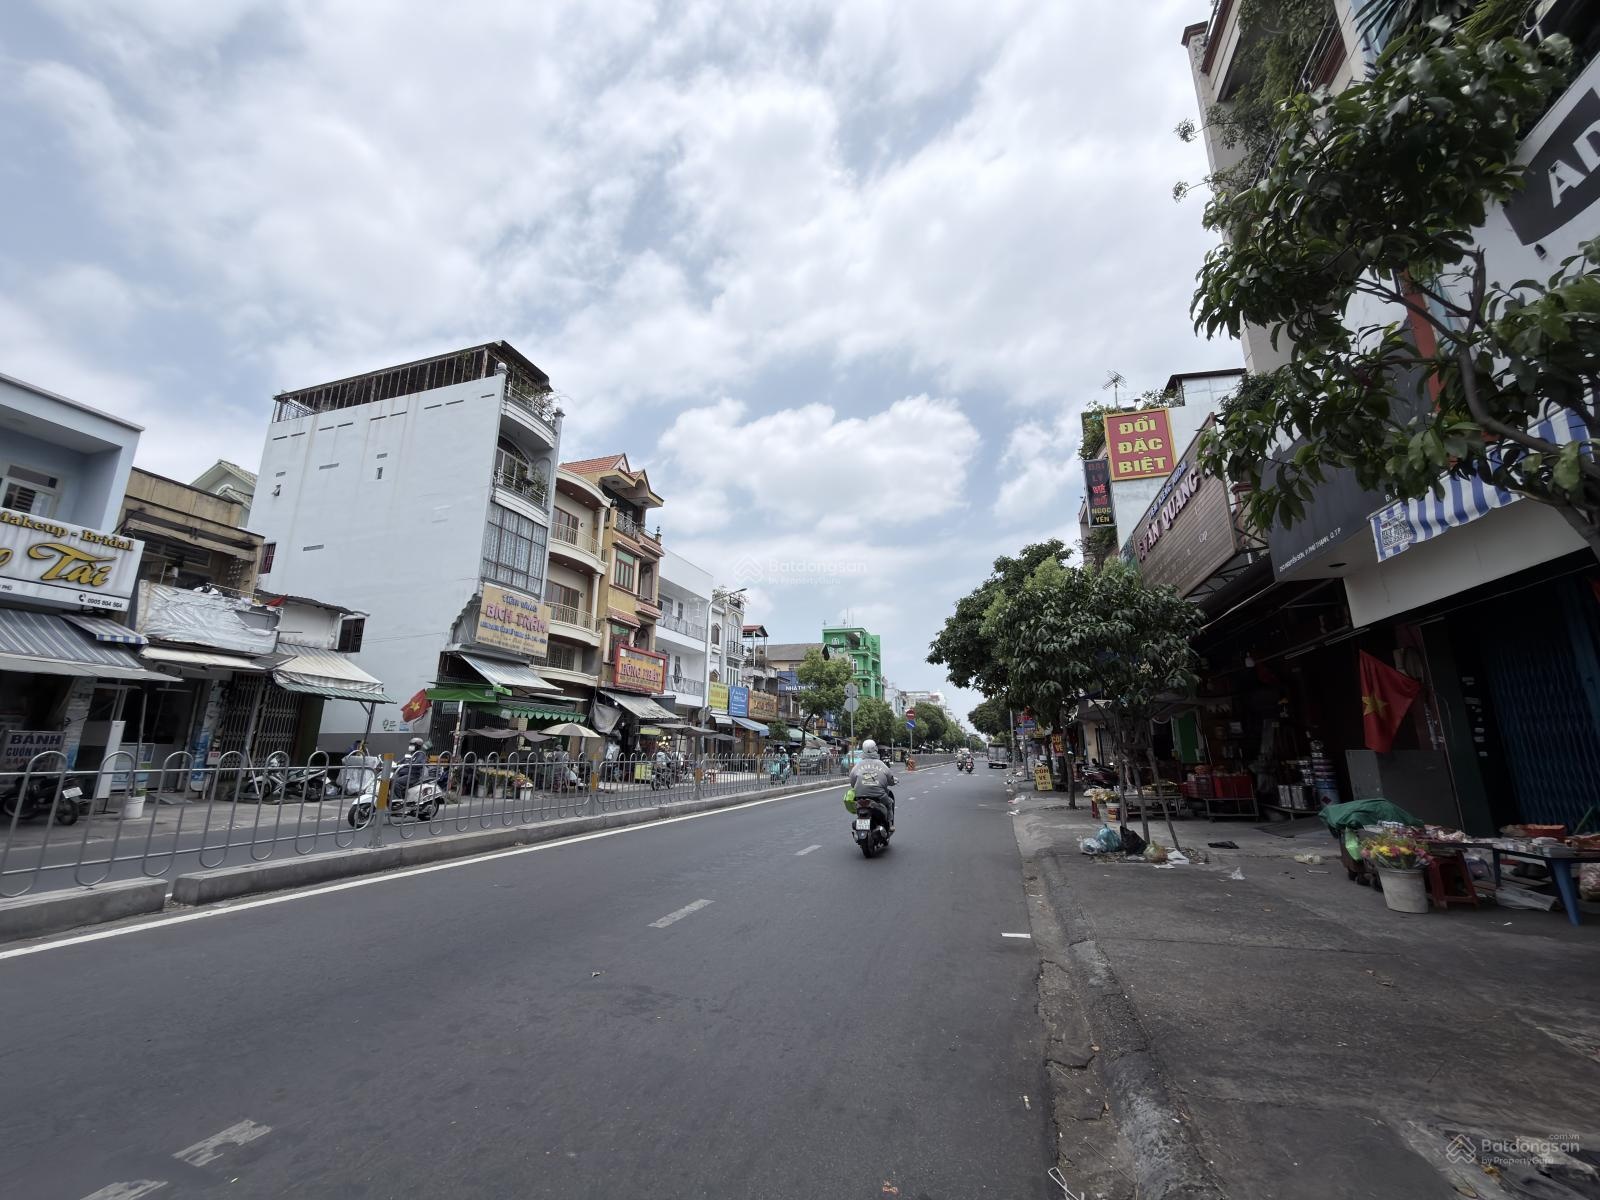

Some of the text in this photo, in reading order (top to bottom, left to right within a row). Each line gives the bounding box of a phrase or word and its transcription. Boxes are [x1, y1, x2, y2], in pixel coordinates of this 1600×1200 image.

[1119, 416, 1156, 435] ĐỔI
[1118, 438, 1163, 454] ĐẶC
[1118, 456, 1166, 474] BIỆT
[1161, 468, 1200, 530] QUANG
[1091, 507, 1111, 516] NGỌC
[81, 530, 134, 551] Bridal
[27, 542, 118, 586] Tài
[516, 612, 547, 633] TRÂM
